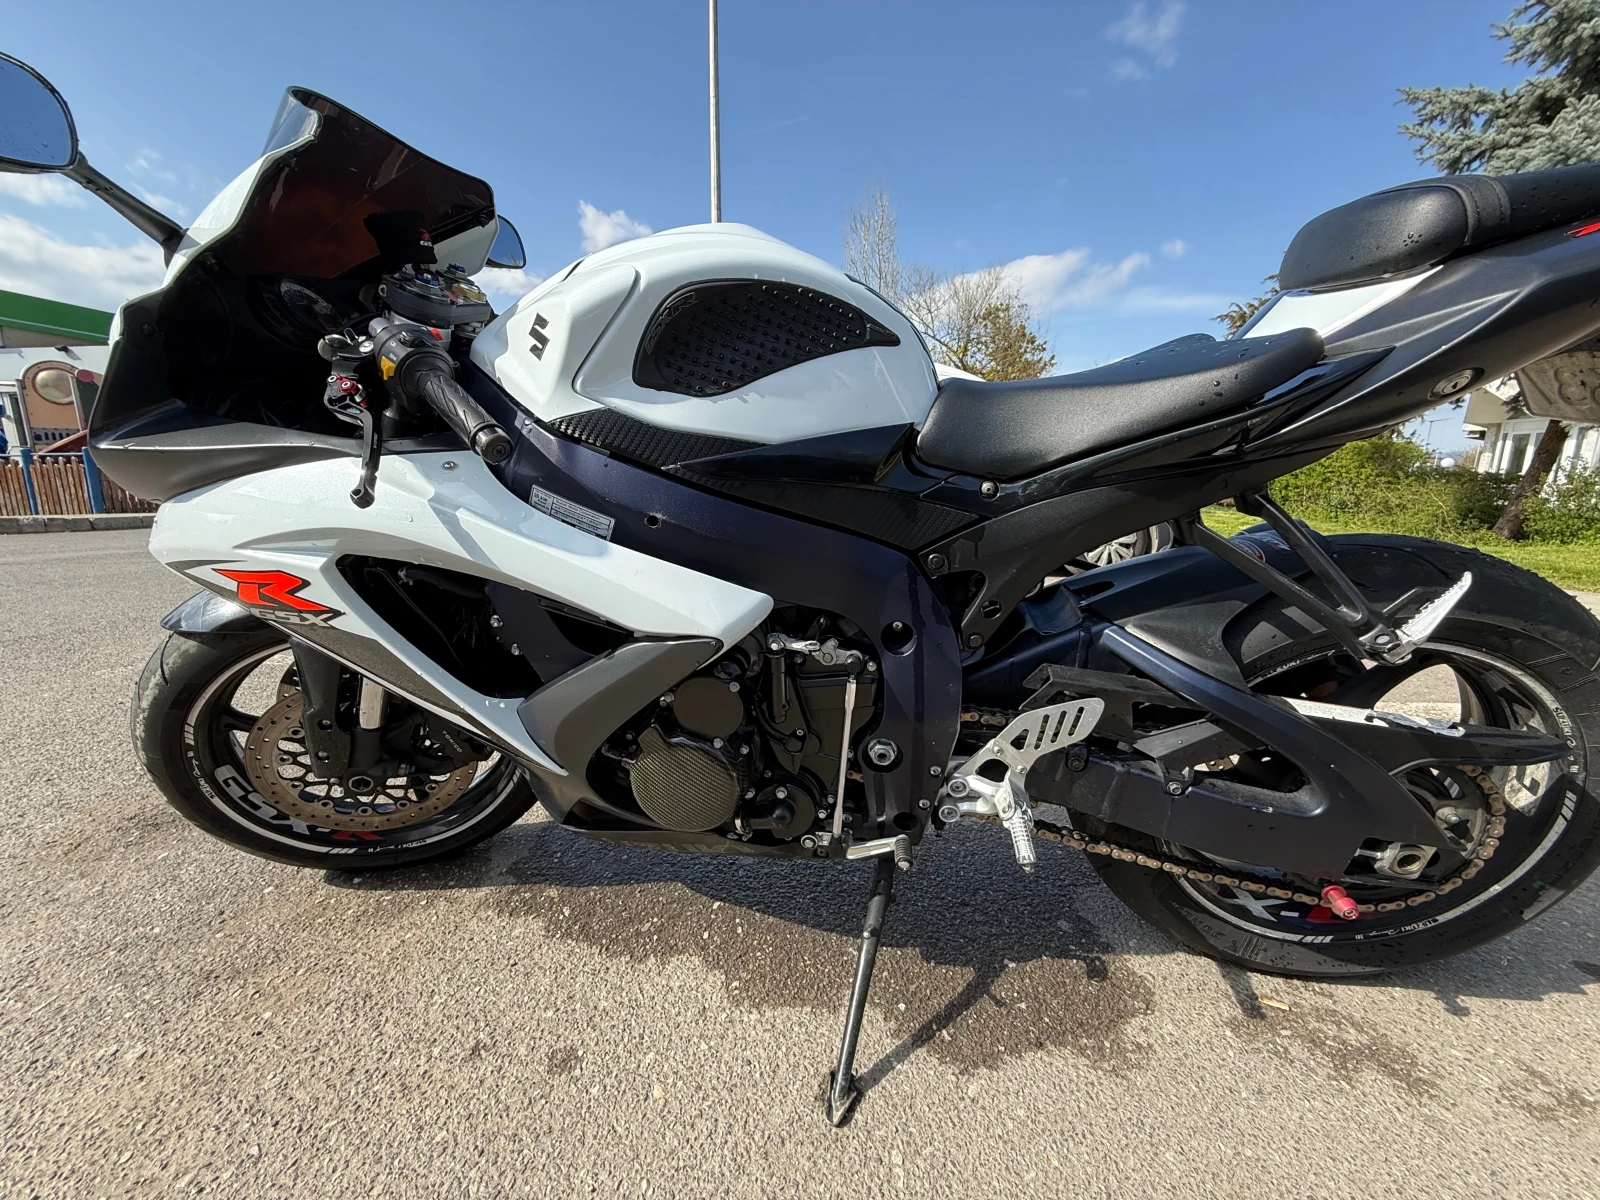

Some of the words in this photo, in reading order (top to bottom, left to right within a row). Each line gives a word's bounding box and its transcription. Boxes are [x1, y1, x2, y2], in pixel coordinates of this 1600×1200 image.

[256, 610, 331, 627] GSX
[1553, 706, 1573, 736] SUZUKI
[442, 730, 462, 753] TOKICO
[1401, 918, 1439, 932] SUZUKI
